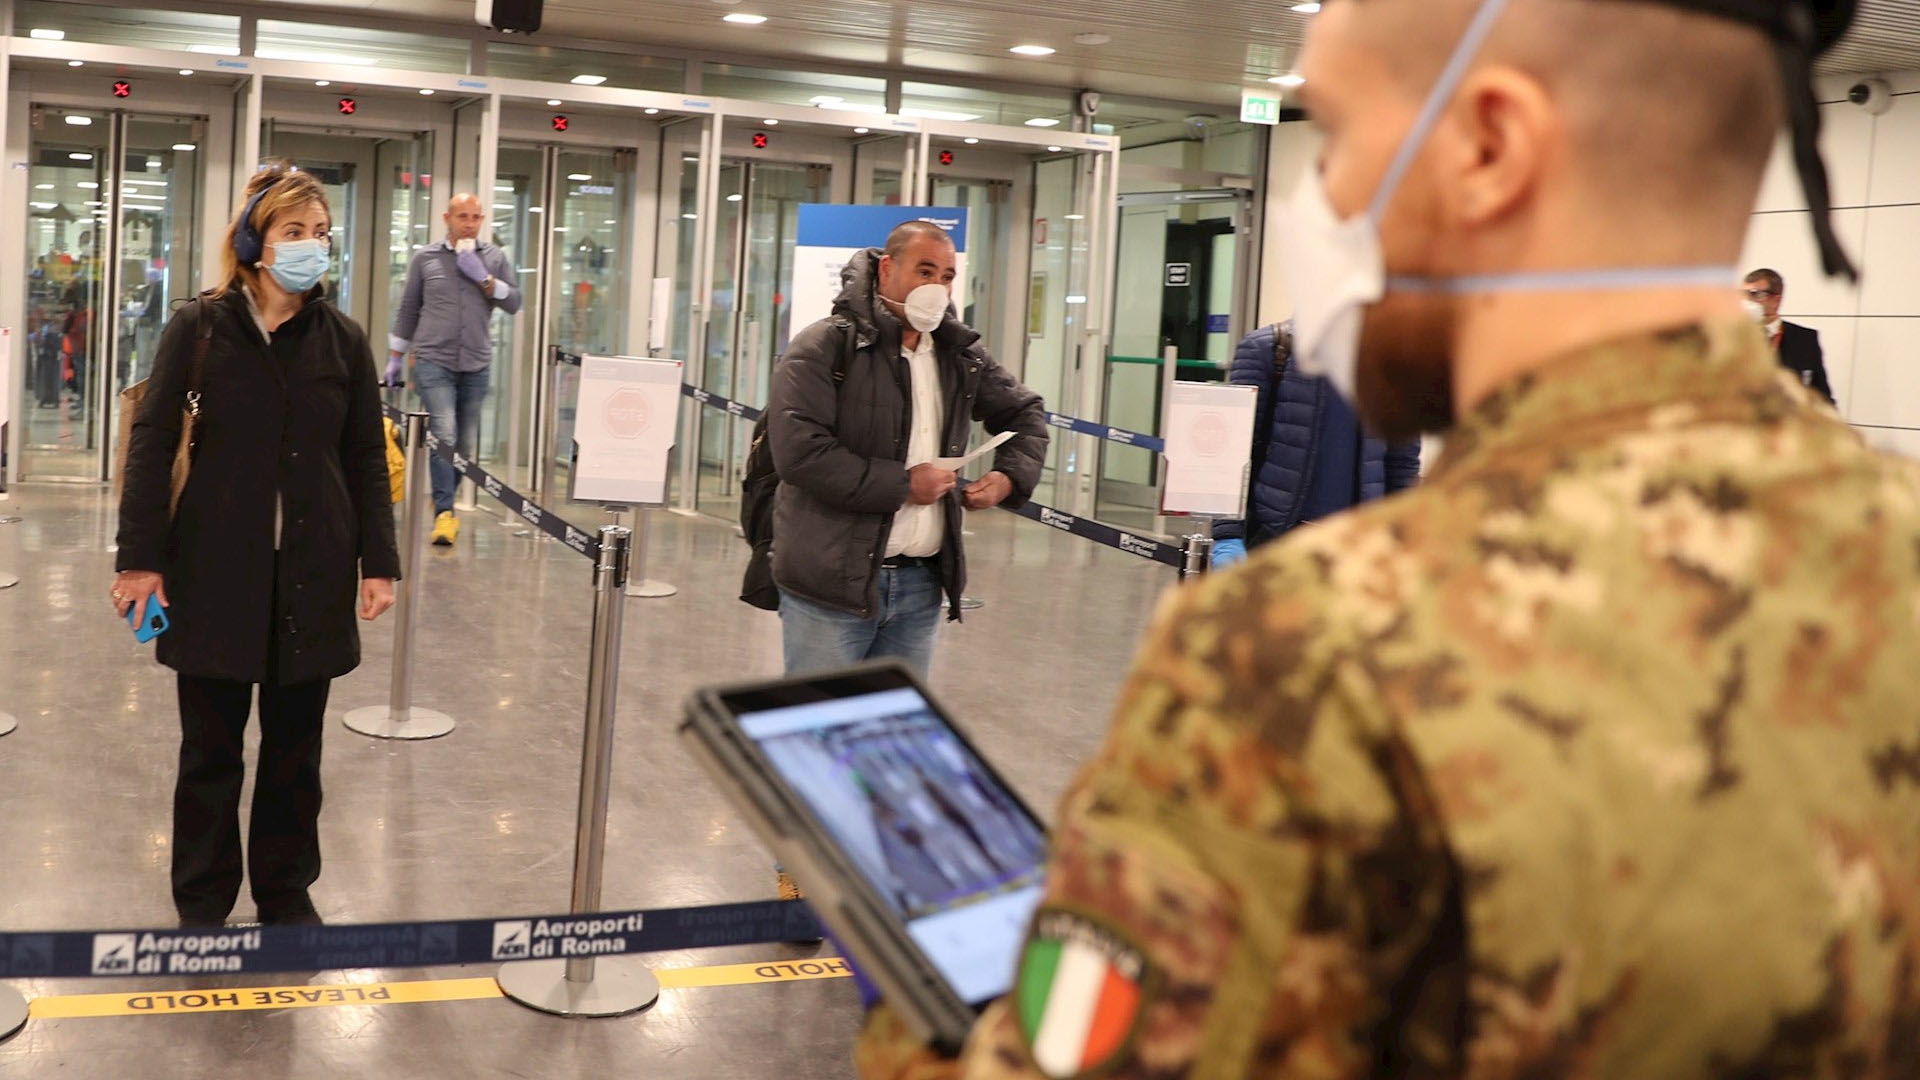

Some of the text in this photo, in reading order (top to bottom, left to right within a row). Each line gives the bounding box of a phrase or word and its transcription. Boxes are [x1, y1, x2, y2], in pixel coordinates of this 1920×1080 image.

[532, 914, 644, 938] Aeroporti
[137, 931, 262, 953] Aeroporti
[532, 937, 626, 957] di Roma
[136, 953, 242, 974] di Roma
[755, 961, 852, 978] HOLD
[127, 987, 392, 1010] PLEASE HOLD
